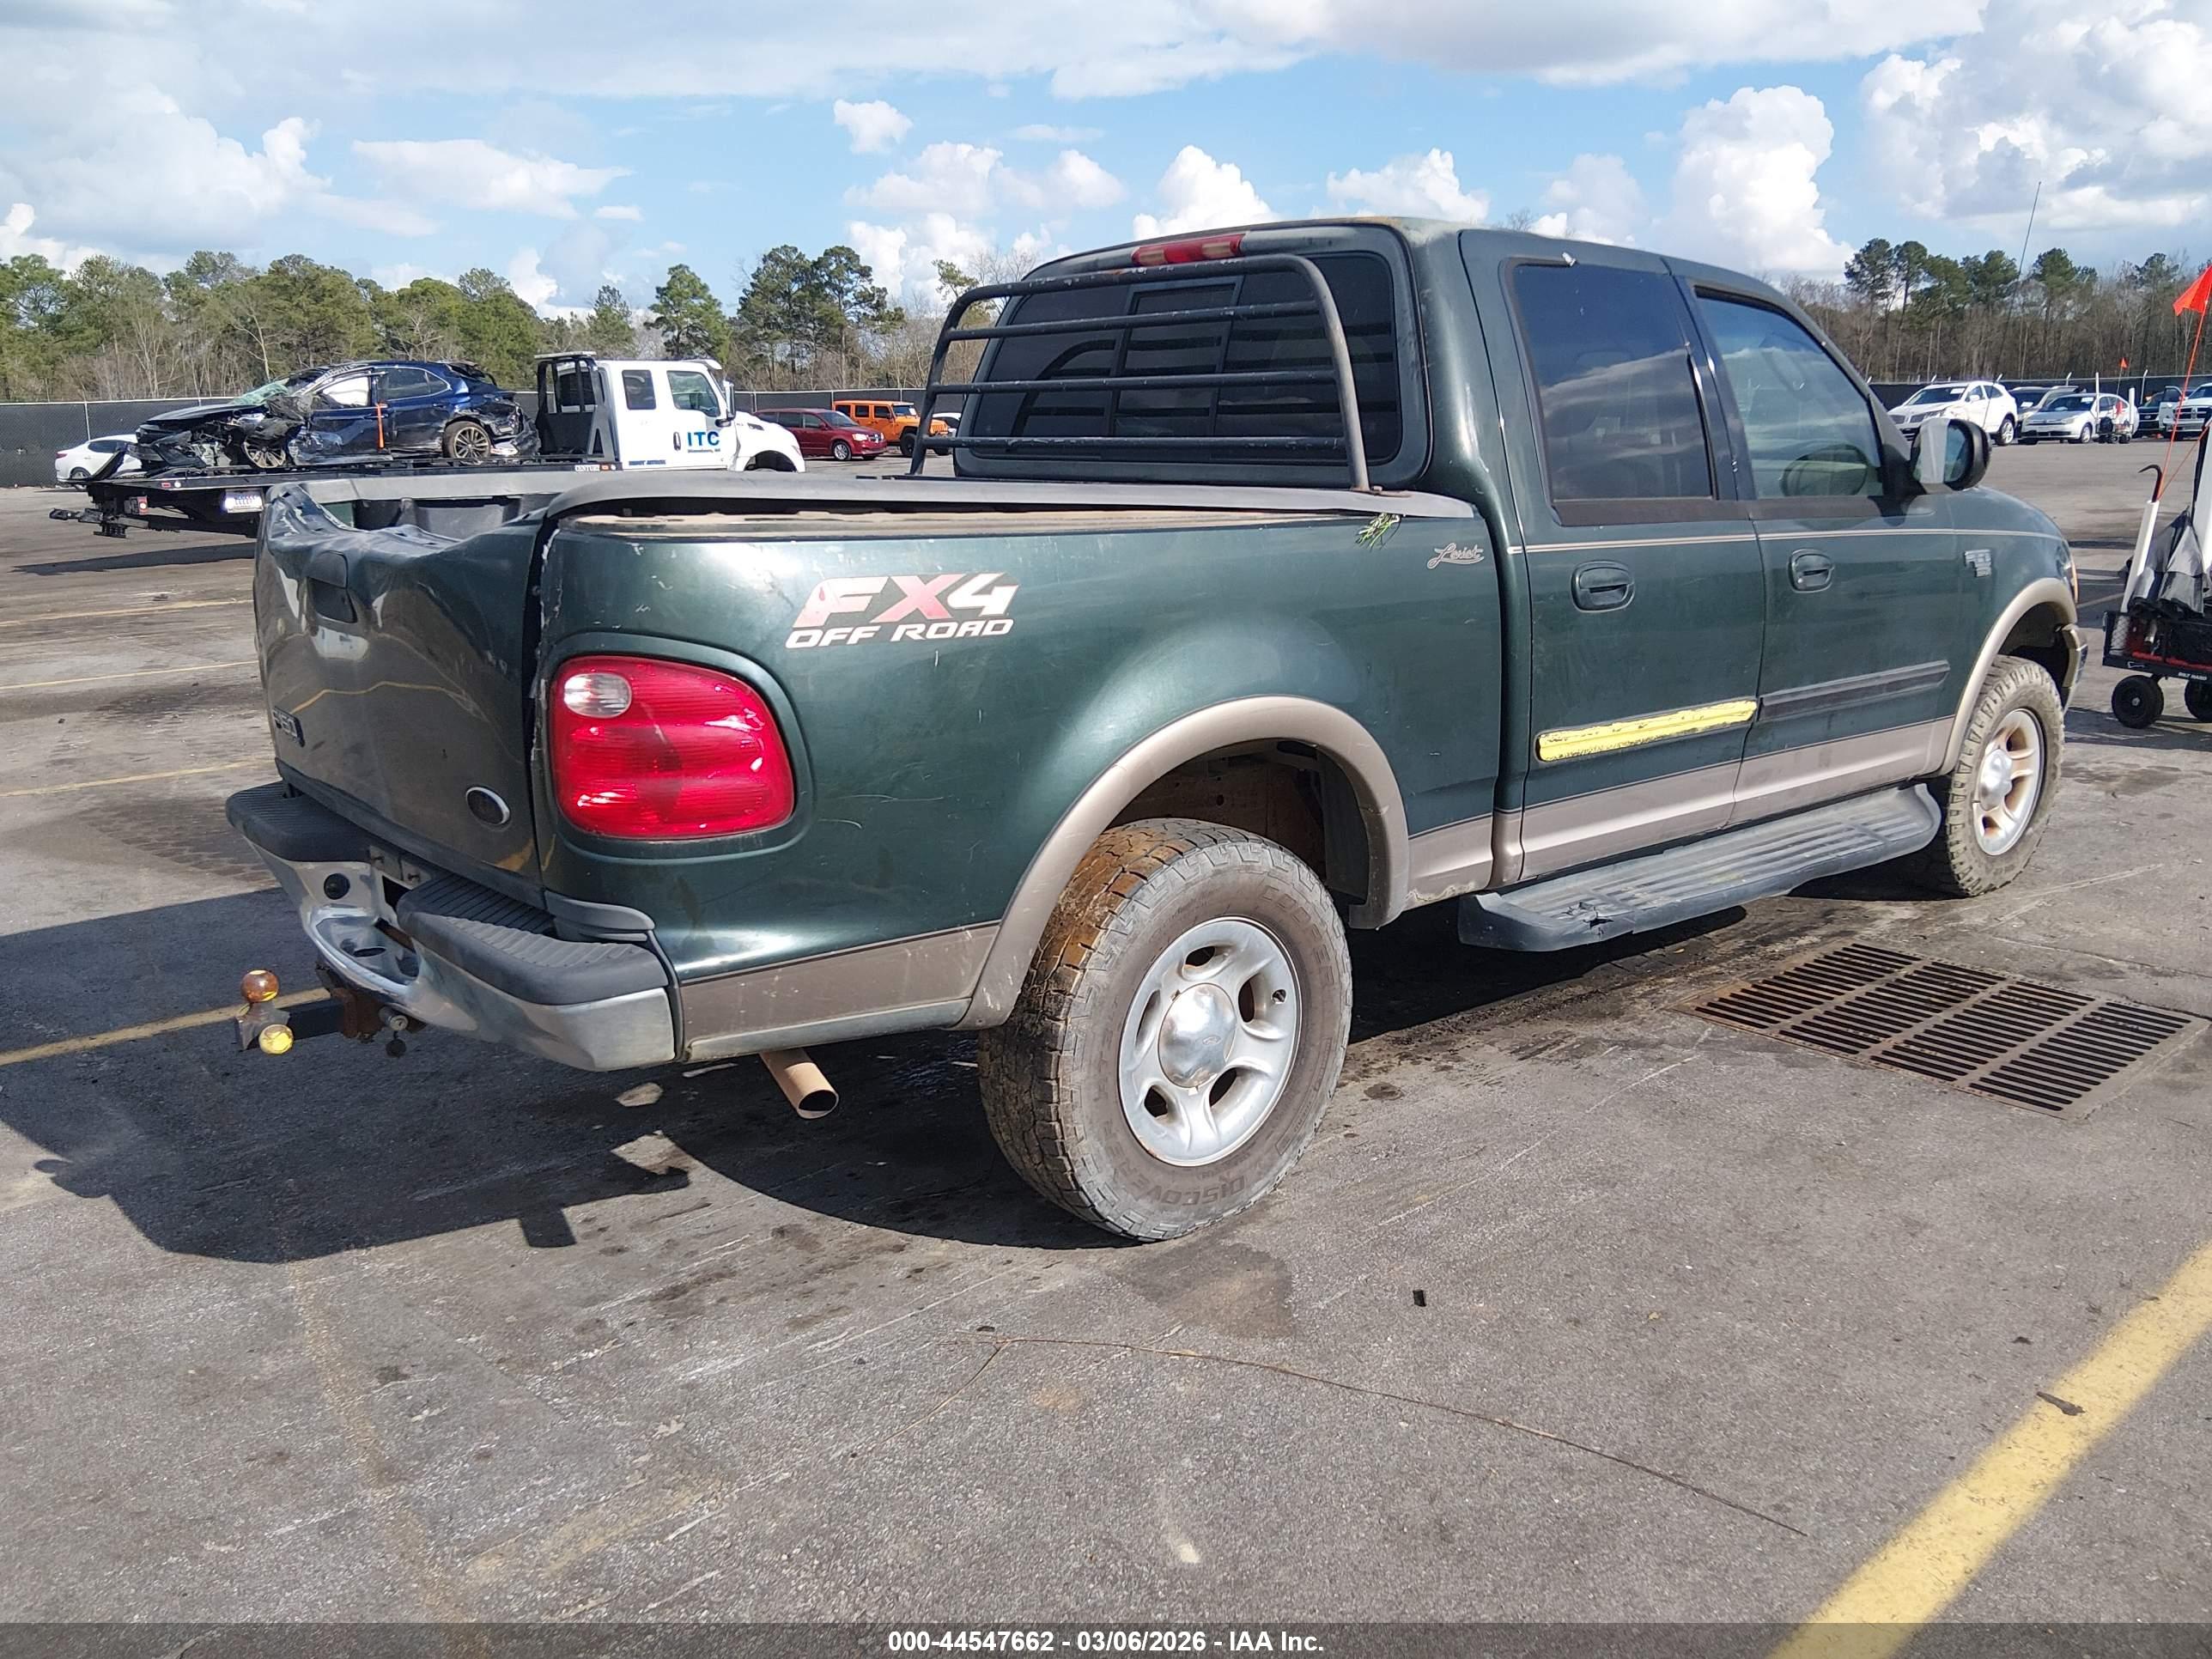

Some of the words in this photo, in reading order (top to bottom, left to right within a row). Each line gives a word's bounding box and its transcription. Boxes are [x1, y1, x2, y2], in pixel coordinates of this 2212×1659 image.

[687, 430, 720, 447] ITC
[792, 571, 1020, 629] FX4
[785, 624, 882, 649] OFF
[890, 617, 1014, 642] ROAD
